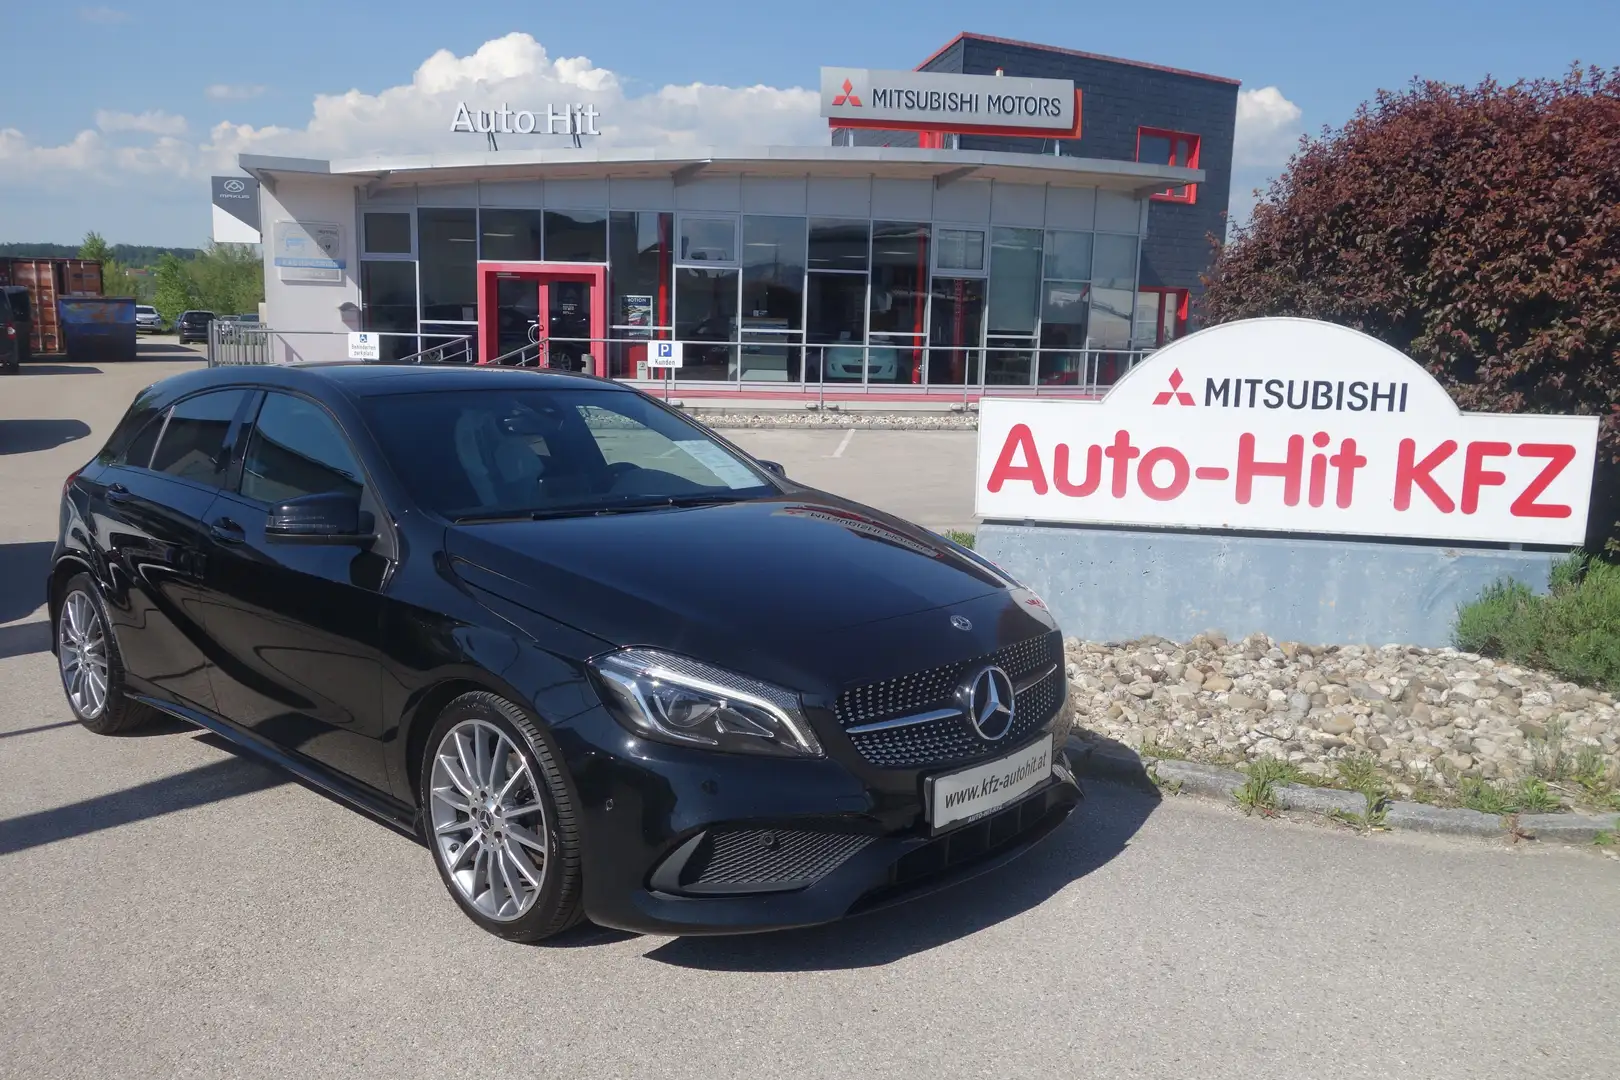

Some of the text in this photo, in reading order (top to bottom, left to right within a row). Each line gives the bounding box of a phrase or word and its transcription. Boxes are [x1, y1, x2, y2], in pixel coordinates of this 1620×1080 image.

[450, 101, 602, 135] Auto Hit
[872, 88, 1061, 117] MITSUBISHI MOTORS
[654, 358, 676, 366] Kunden
[661, 344, 669, 357] P
[1204, 377, 1408, 413] MITSUBISHI
[986, 423, 1577, 519] Auto-Hit KFZ
[944, 751, 1047, 809] www.kfz-autohit.at
